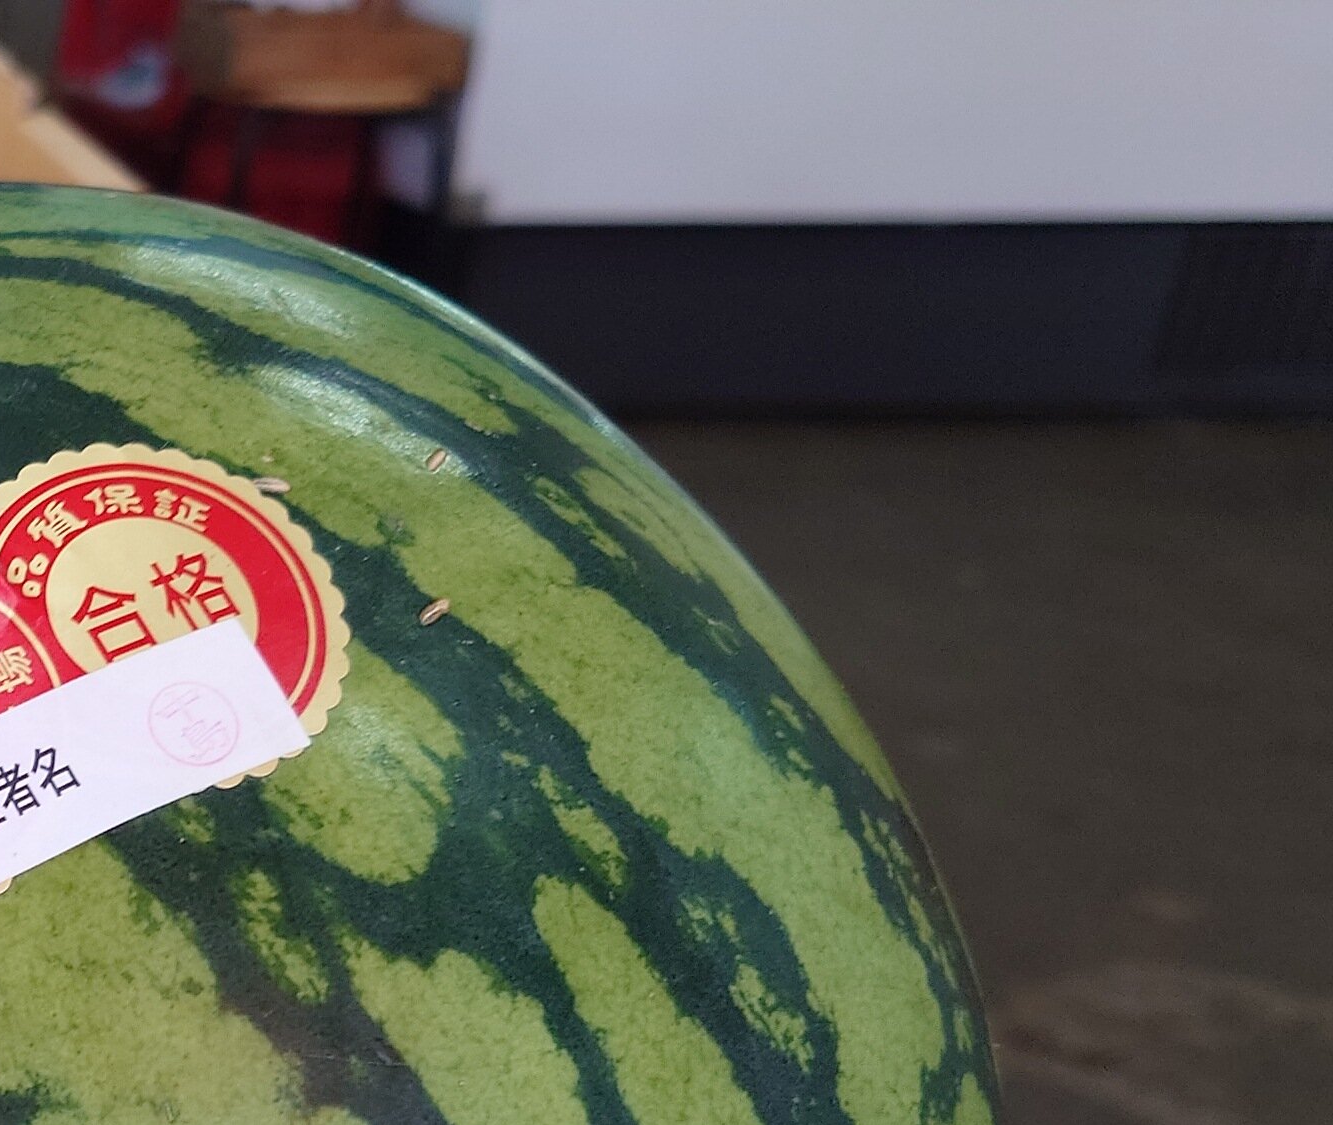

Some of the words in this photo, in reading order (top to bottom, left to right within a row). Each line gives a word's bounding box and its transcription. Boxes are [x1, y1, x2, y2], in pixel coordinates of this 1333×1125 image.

[7, 485, 211, 598] 品質保証
[70, 553, 241, 665] 合格
